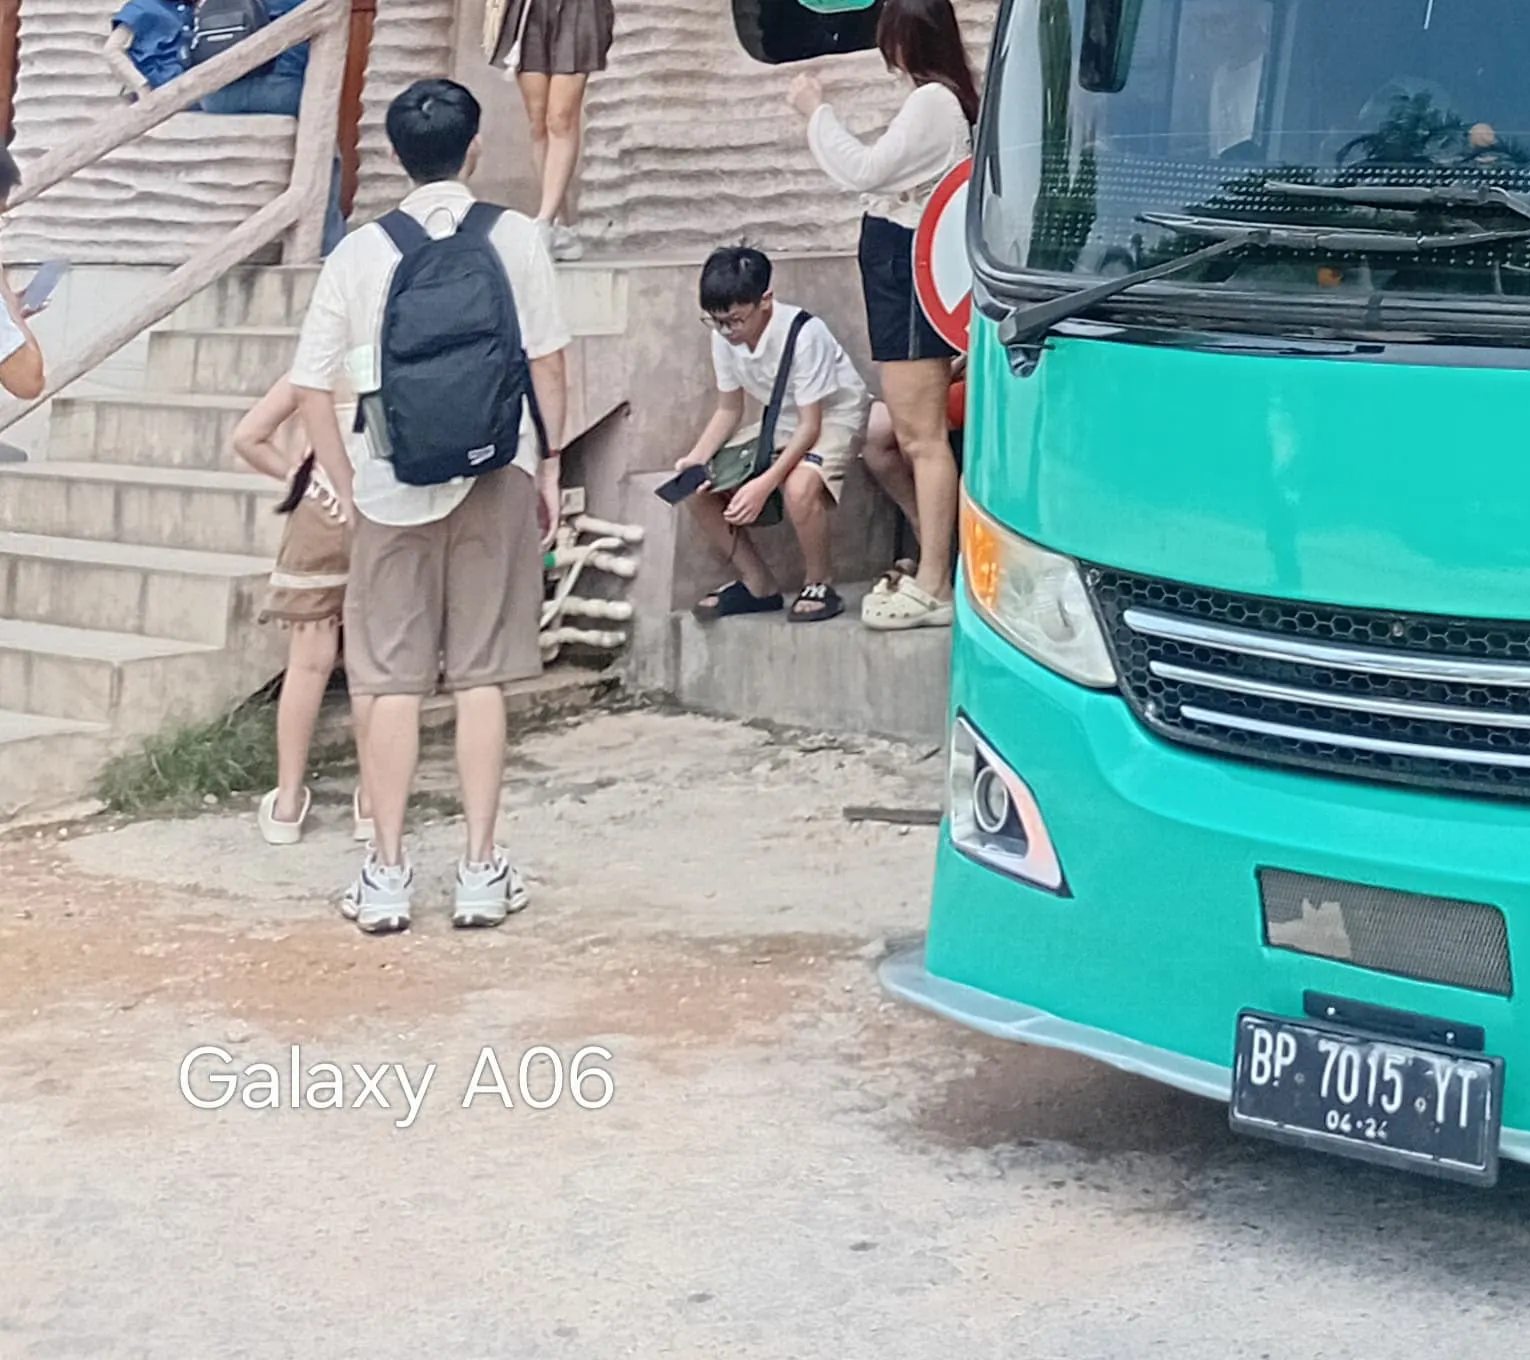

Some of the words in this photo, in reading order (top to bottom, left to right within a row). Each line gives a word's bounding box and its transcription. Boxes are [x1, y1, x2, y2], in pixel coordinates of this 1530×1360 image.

[1250, 1028, 1297, 1086] BP
[1318, 1039, 1406, 1114] 7015
[1433, 1058, 1479, 1128] YT
